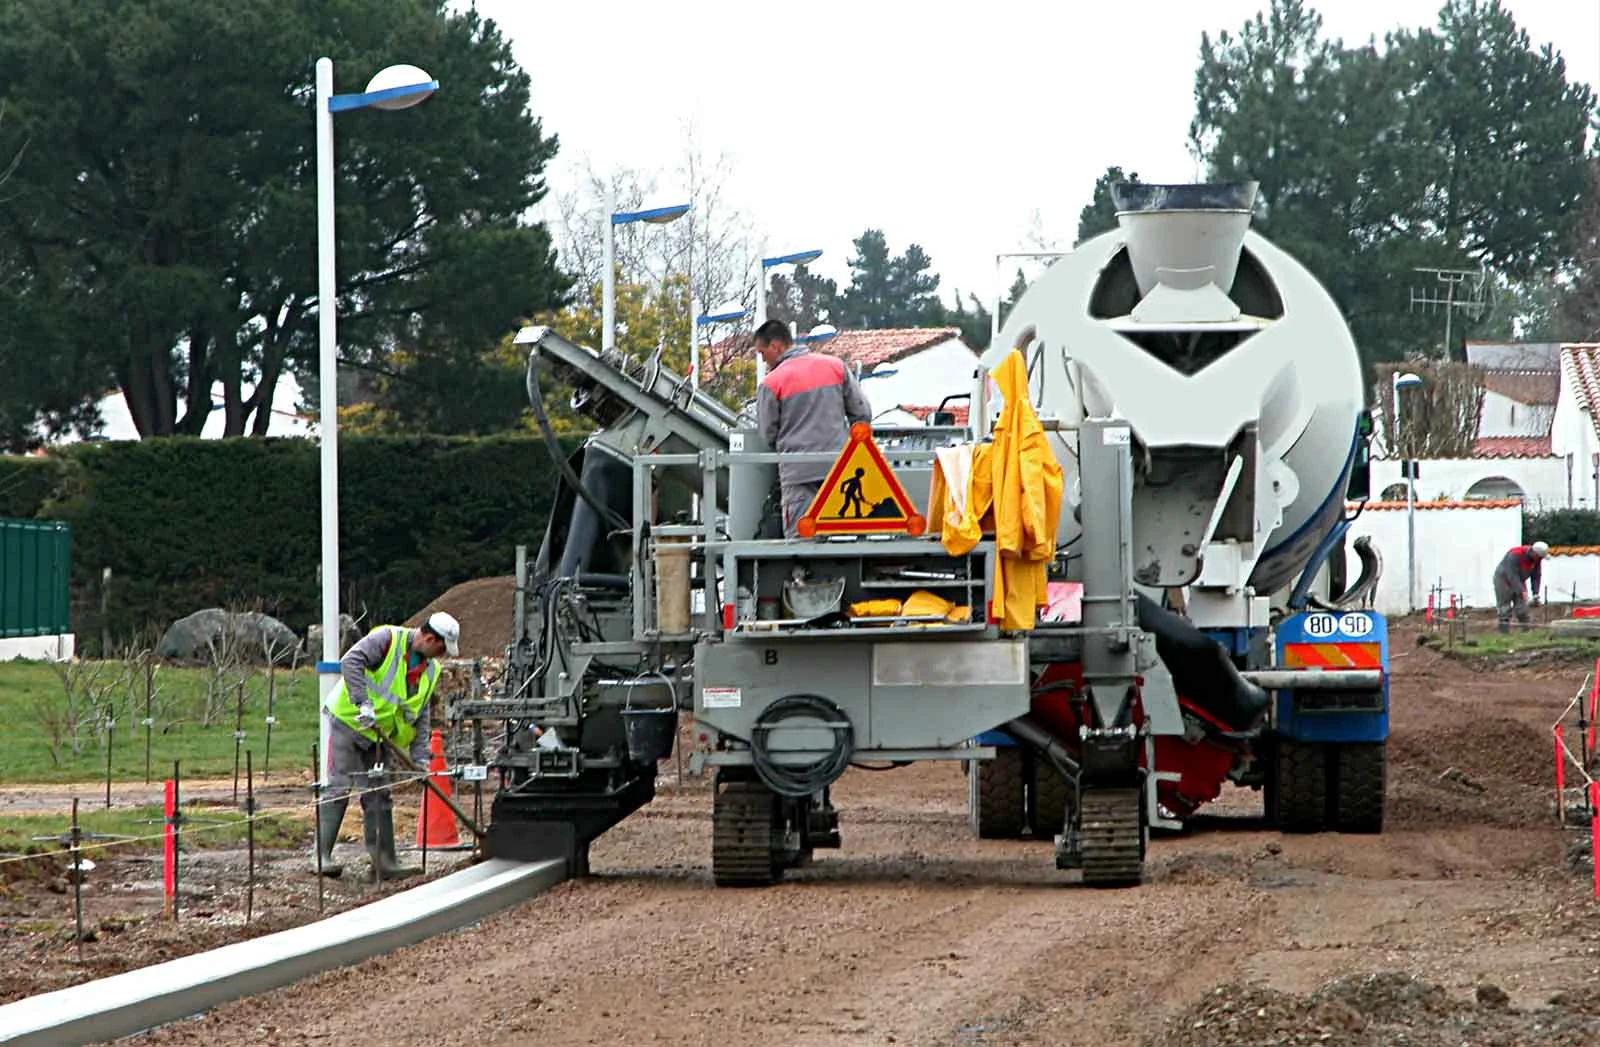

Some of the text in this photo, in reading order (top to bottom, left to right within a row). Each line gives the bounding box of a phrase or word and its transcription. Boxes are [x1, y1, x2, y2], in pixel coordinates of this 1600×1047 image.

[1310, 616, 1332, 633] 80
[1344, 616, 1366, 633] 90
[765, 647, 778, 664] B
